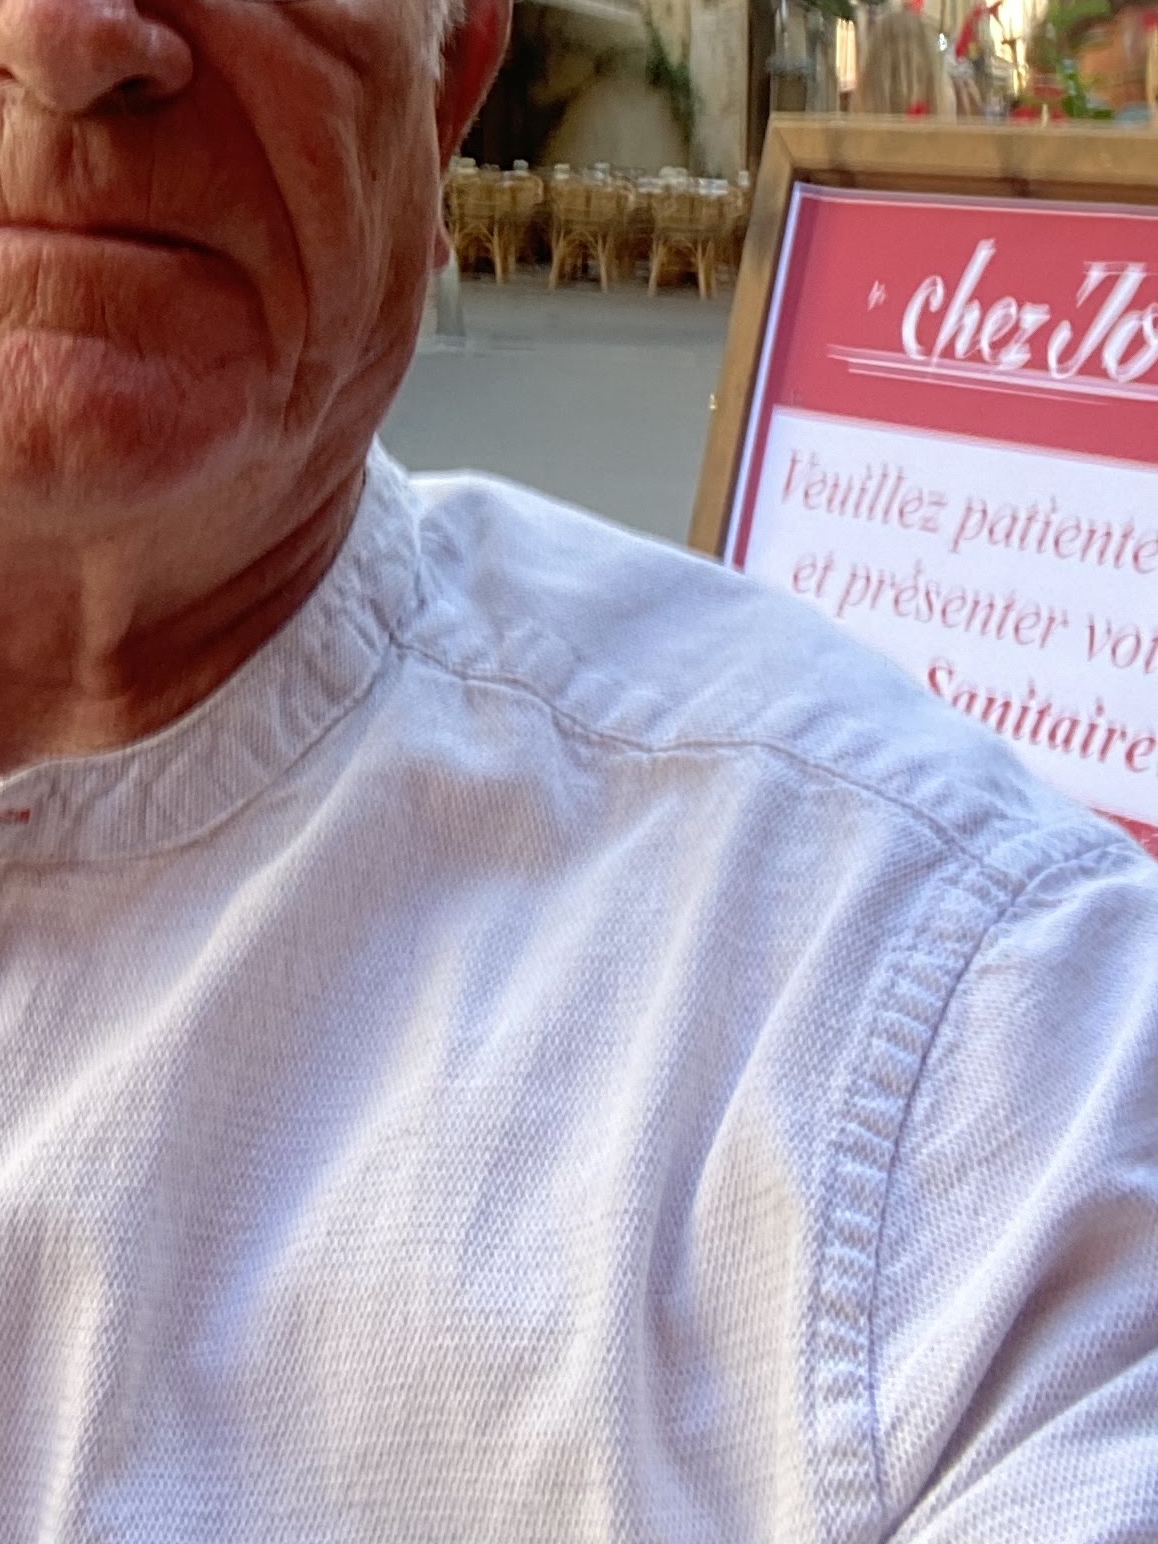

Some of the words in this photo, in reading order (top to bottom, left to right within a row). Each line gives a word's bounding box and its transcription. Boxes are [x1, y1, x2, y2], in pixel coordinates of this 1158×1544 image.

[901, 238, 1050, 371] chez
[782, 449, 948, 533] Veuillez
[949, 496, 1158, 574] patiente
[792, 552, 835, 597] et
[836, 560, 1069, 648] présenter
